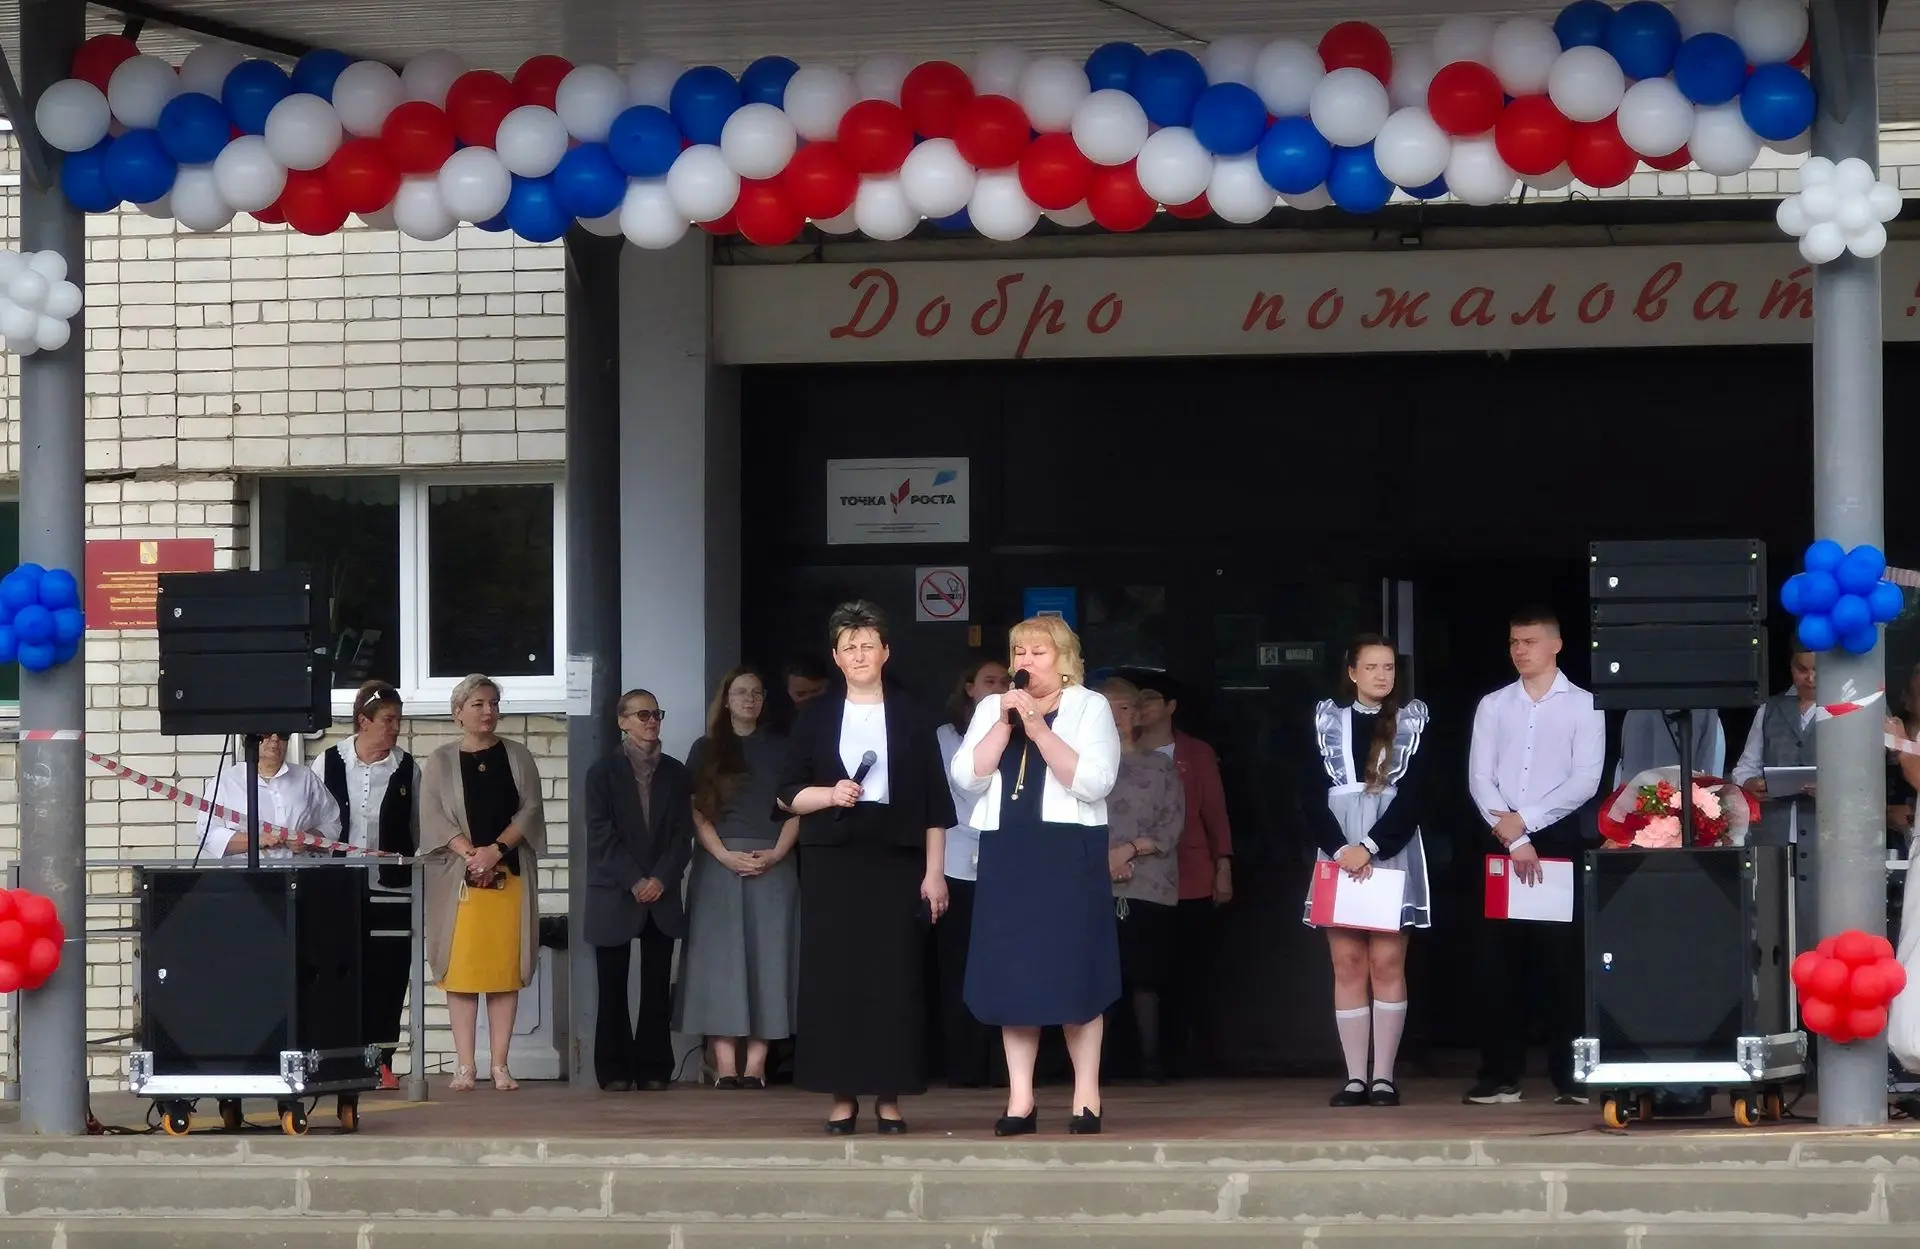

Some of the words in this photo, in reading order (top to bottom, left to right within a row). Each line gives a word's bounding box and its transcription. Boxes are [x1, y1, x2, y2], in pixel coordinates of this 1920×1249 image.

[829, 267, 1124, 356] Добро
[1241, 260, 1814, 333] пожаловат
[839, 495, 887, 506] ТОЧКА
[910, 494, 956, 505] РОСТА
